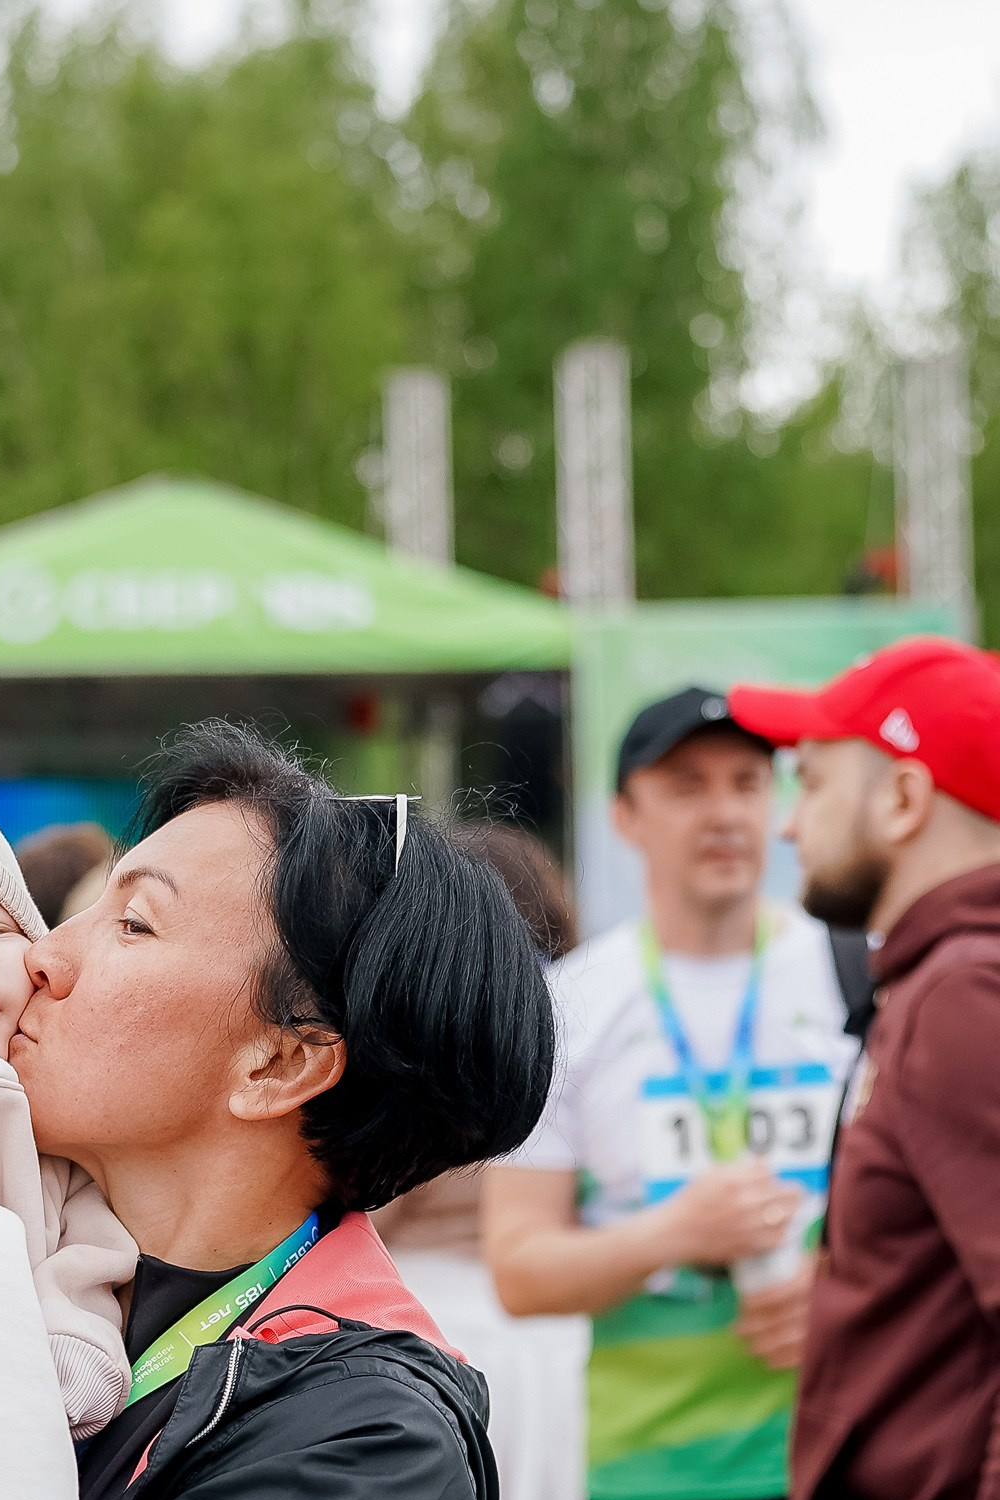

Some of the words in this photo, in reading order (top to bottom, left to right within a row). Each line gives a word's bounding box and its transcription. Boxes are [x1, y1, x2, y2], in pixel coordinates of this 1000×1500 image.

[673, 1106, 816, 1159] 103
[235, 1283, 266, 1311] 185
[200, 1303, 231, 1331] лет
[134, 1344, 175, 1376] марафон
[135, 1353, 175, 1383] зелёный
